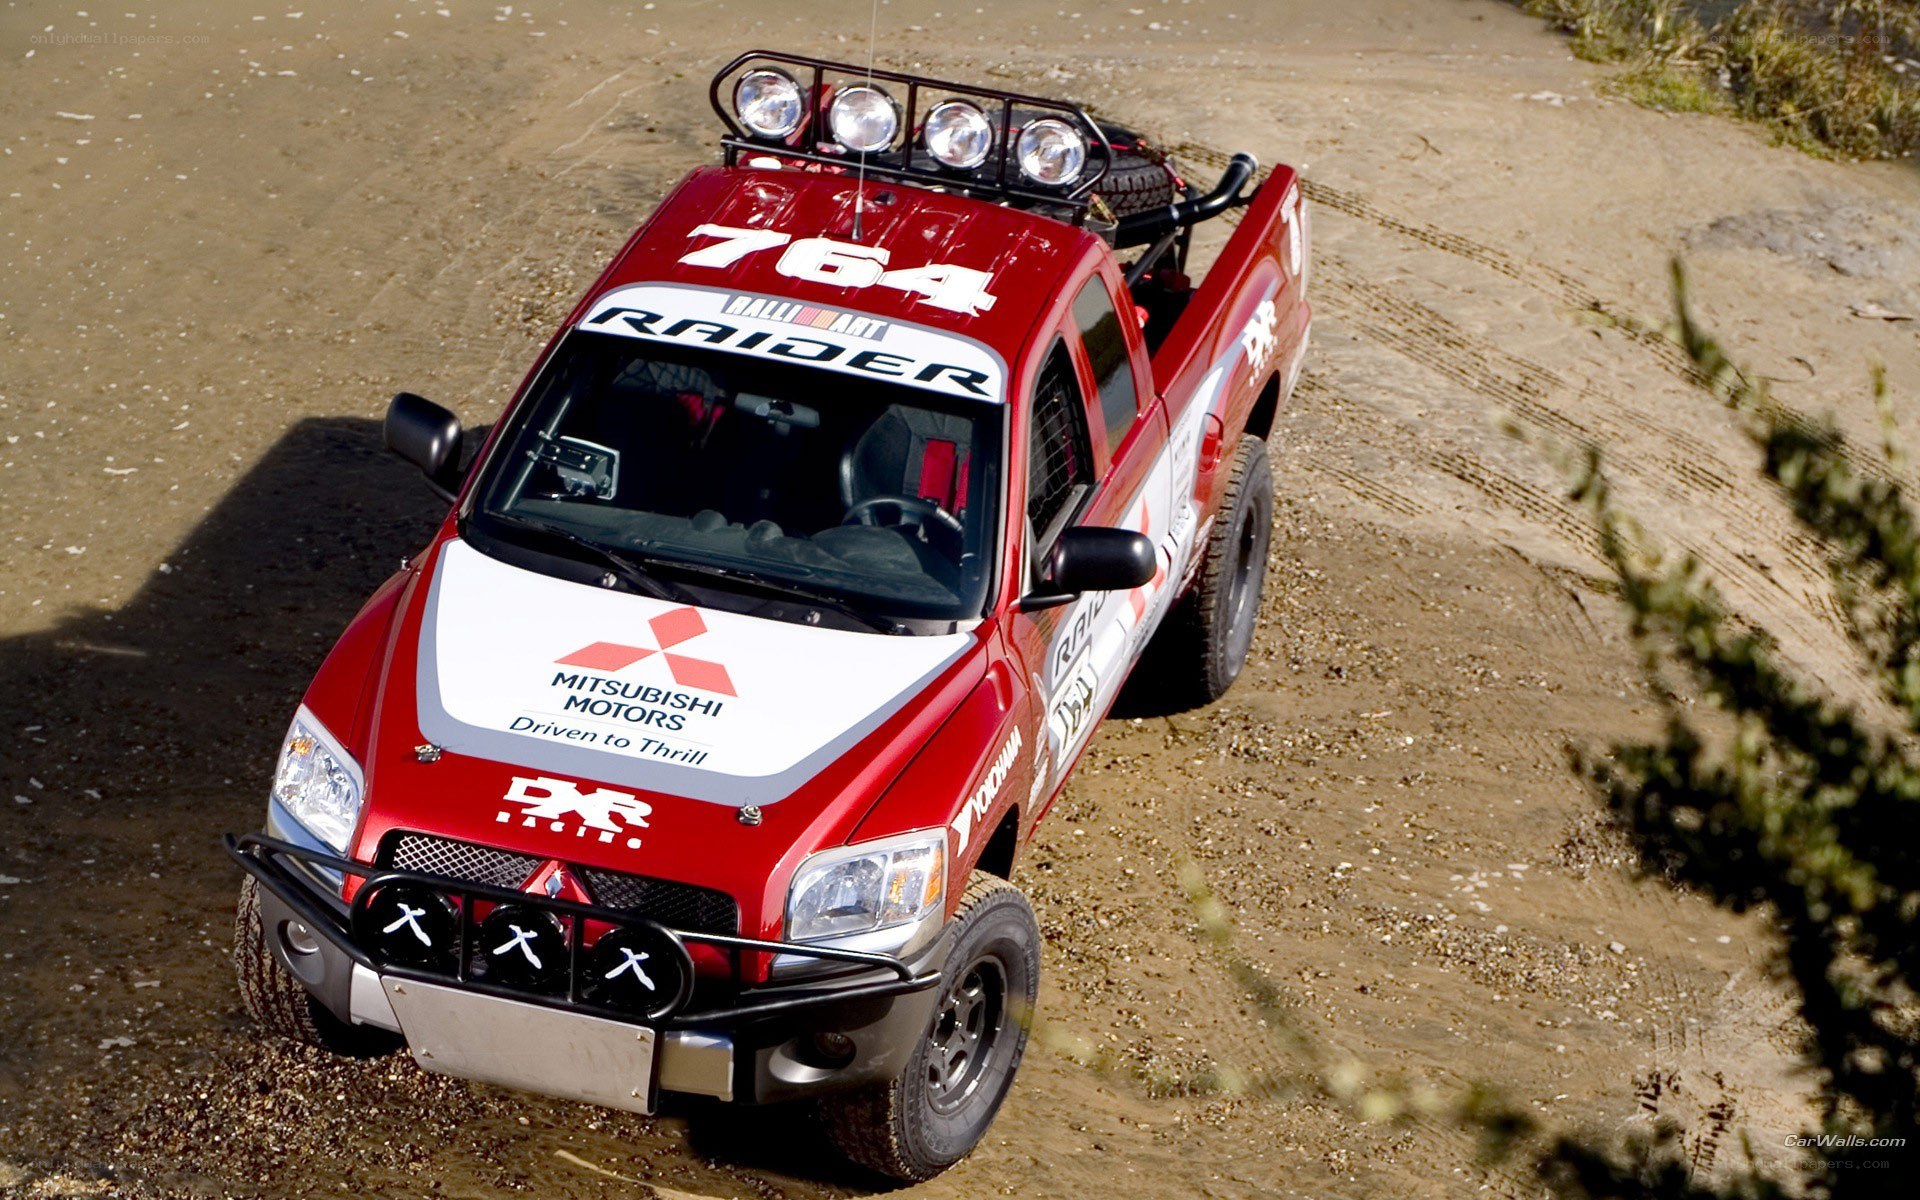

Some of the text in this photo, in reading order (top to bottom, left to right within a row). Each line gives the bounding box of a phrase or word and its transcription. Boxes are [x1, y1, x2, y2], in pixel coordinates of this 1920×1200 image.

[677, 223, 997, 317] 764
[589, 306, 992, 398] RAIDER
[551, 671, 724, 718] MITSUBISHI
[563, 695, 687, 732] MOTORS
[509, 716, 709, 766] Driven to Thrill
